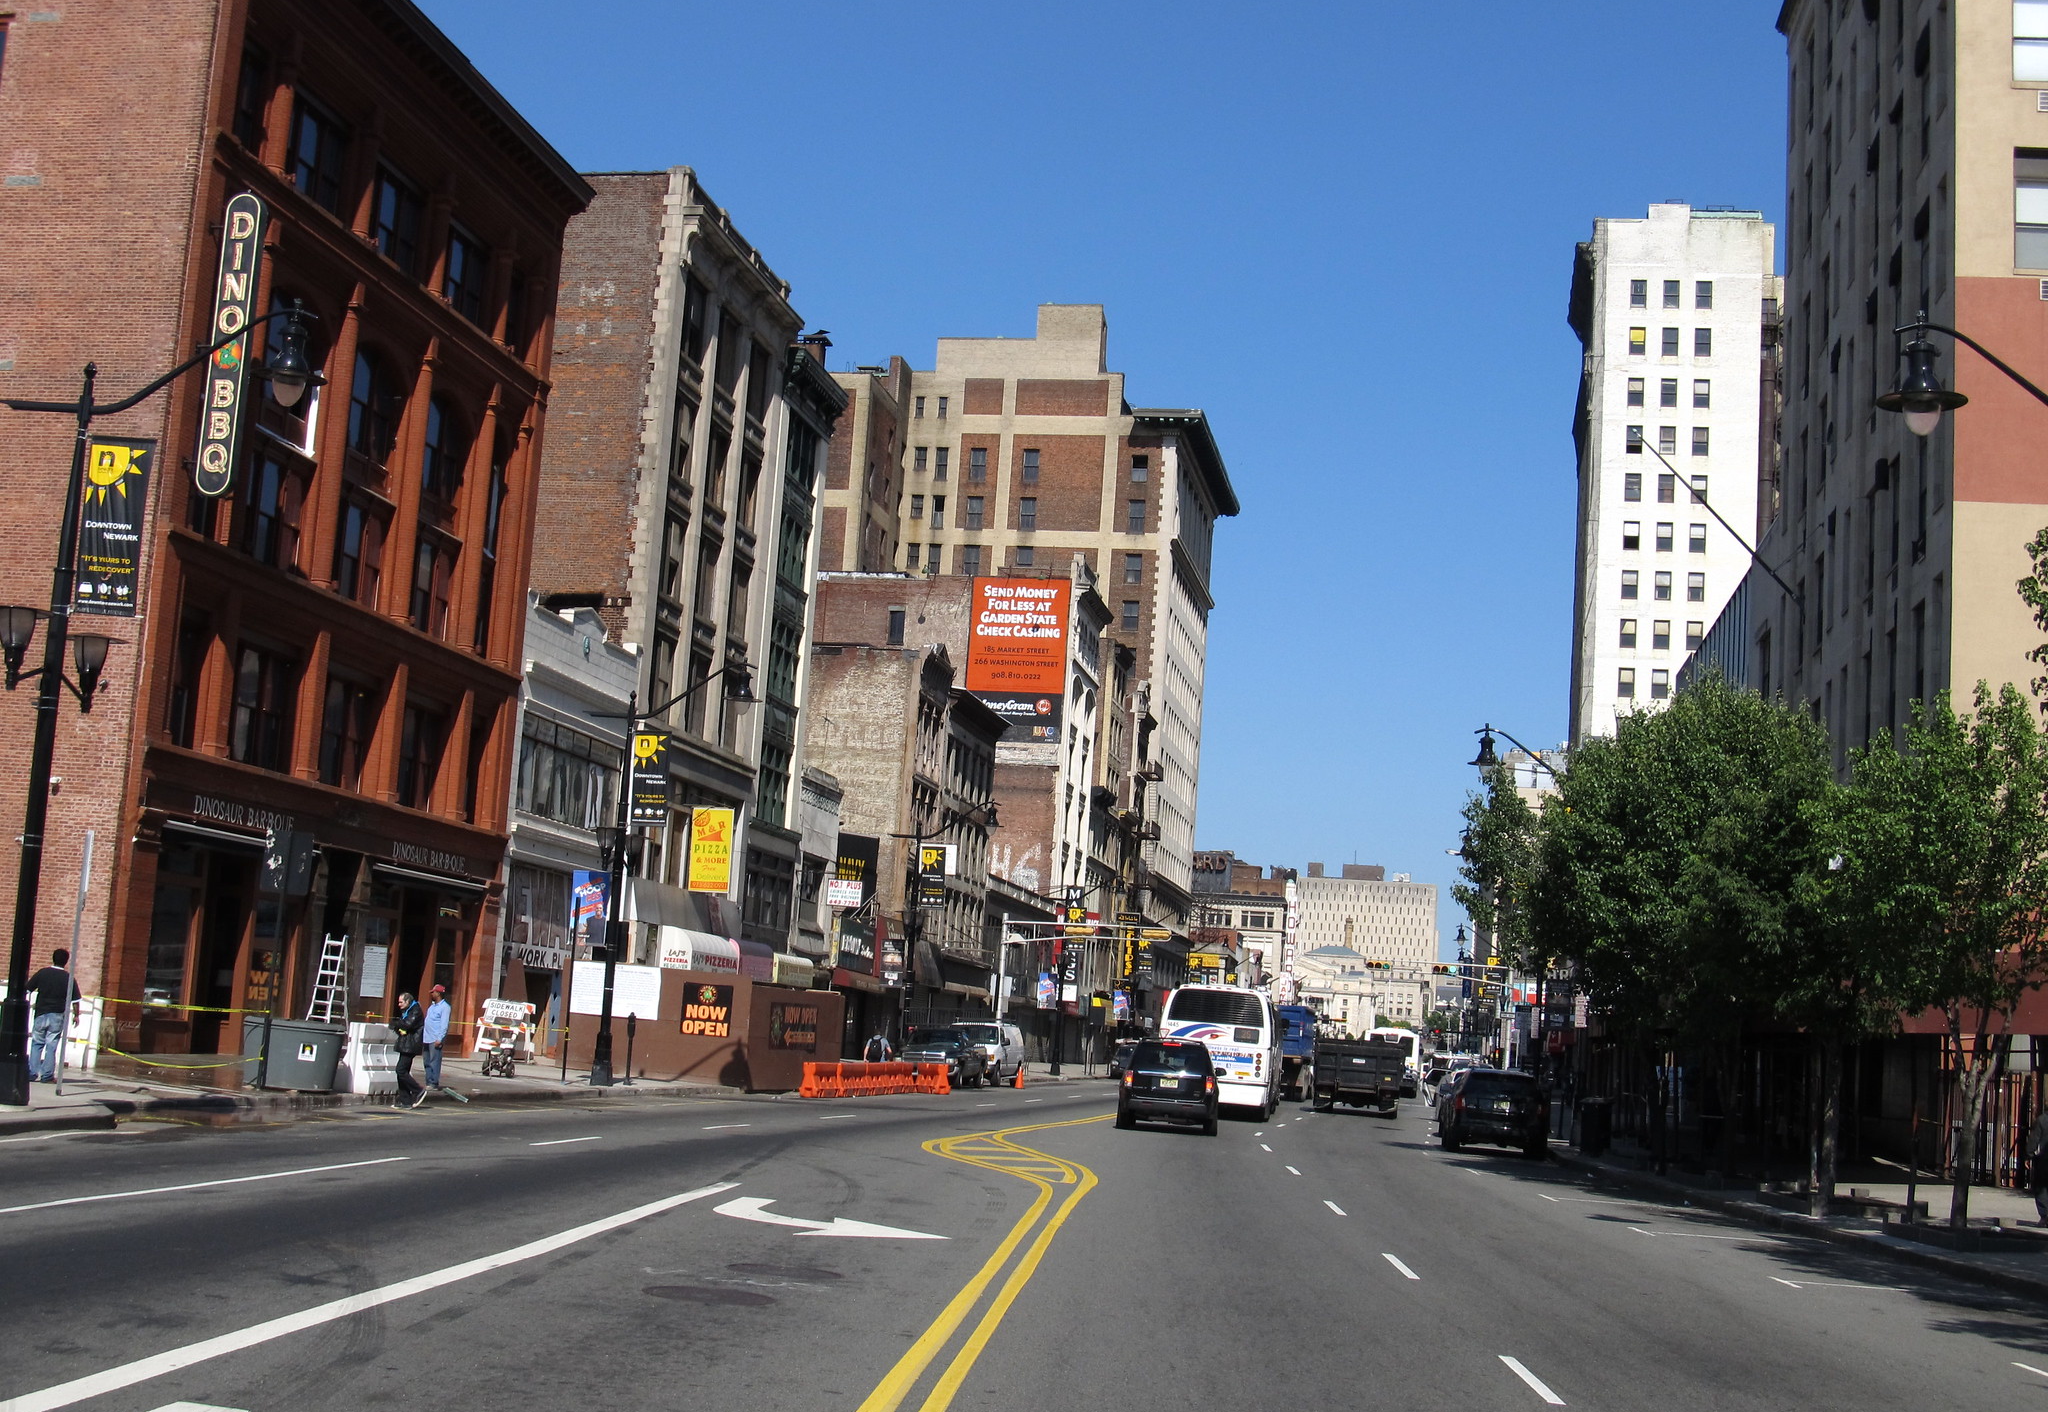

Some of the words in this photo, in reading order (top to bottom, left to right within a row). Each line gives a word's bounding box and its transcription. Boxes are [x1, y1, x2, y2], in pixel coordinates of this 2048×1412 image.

[218, 211, 255, 335] DINO
[201, 379, 235, 474] BBQ
[85, 520, 132, 531] DOWNTOWN
[103, 532, 139, 542] NEWARK
[984, 585, 1014, 598] SEND
[1015, 586, 1058, 599] MONEY
[988, 598, 1009, 611] FOR
[1010, 599, 1035, 612] LESS
[1035, 601, 1052, 612] AT
[980, 611, 1025, 624] GARDEN
[1025, 613, 1057, 625] STATE
[976, 624, 1012, 637] CHECK
[1013, 625, 1061, 639] CASHING
[984, 646, 996, 654] 185
[997, 646, 1025, 654] MARKET
[1026, 647, 1050, 655] STREET
[989, 659, 1035, 668] WASHINGTON
[1036, 660, 1059, 668] STREET
[991, 672, 1041, 681] 908.810.0222
[1033, 726, 1055, 737] UAC
[193, 794, 243, 825] DINOSAUR
[697, 827, 706, 837] M
[709, 825, 716, 833] &
[718, 820, 726, 829] R
[392, 841, 429, 865] DINOSAUR
[694, 844, 728, 855] PIZZA
[846, 882, 862, 890] PLUS
[705, 955, 738, 970] PIZZERIA
[490, 1001, 523, 1012] SIDEWALK
[491, 1009, 517, 1018] CLOSED
[686, 1004, 728, 1021] NOW
[785, 1006, 801, 1024] NOW
[801, 1007, 818, 1025] OPEN
[682, 1020, 728, 1037] OPEN
